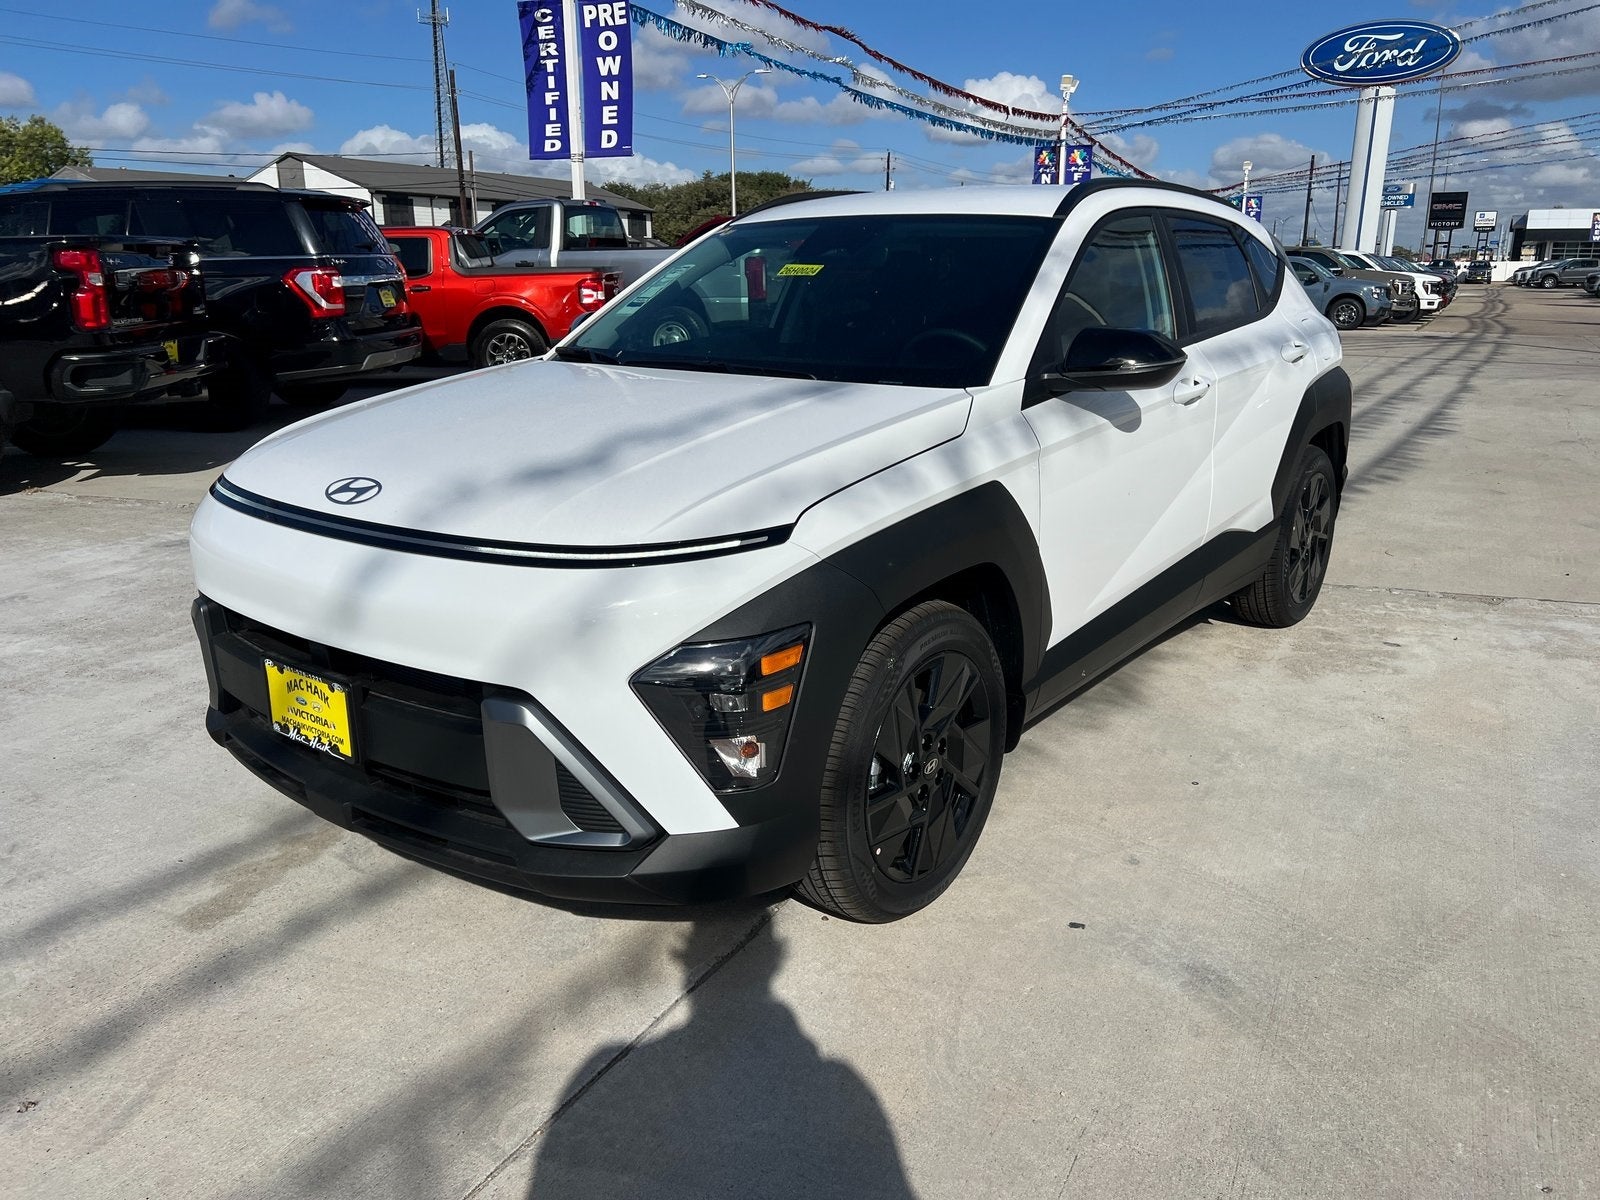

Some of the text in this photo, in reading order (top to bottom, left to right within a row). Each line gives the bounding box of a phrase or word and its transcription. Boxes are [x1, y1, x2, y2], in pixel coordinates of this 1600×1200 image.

[582, 1, 628, 28] PRE
[1333, 32, 1427, 72] Ford
[534, 8, 562, 152] CERTIFIED
[596, 30, 622, 149] OWNED
[286, 678, 304, 694] MAC
[305, 681, 330, 708] HAIK
[293, 708, 329, 728] VICTORIA
[288, 728, 309, 744] Mac
